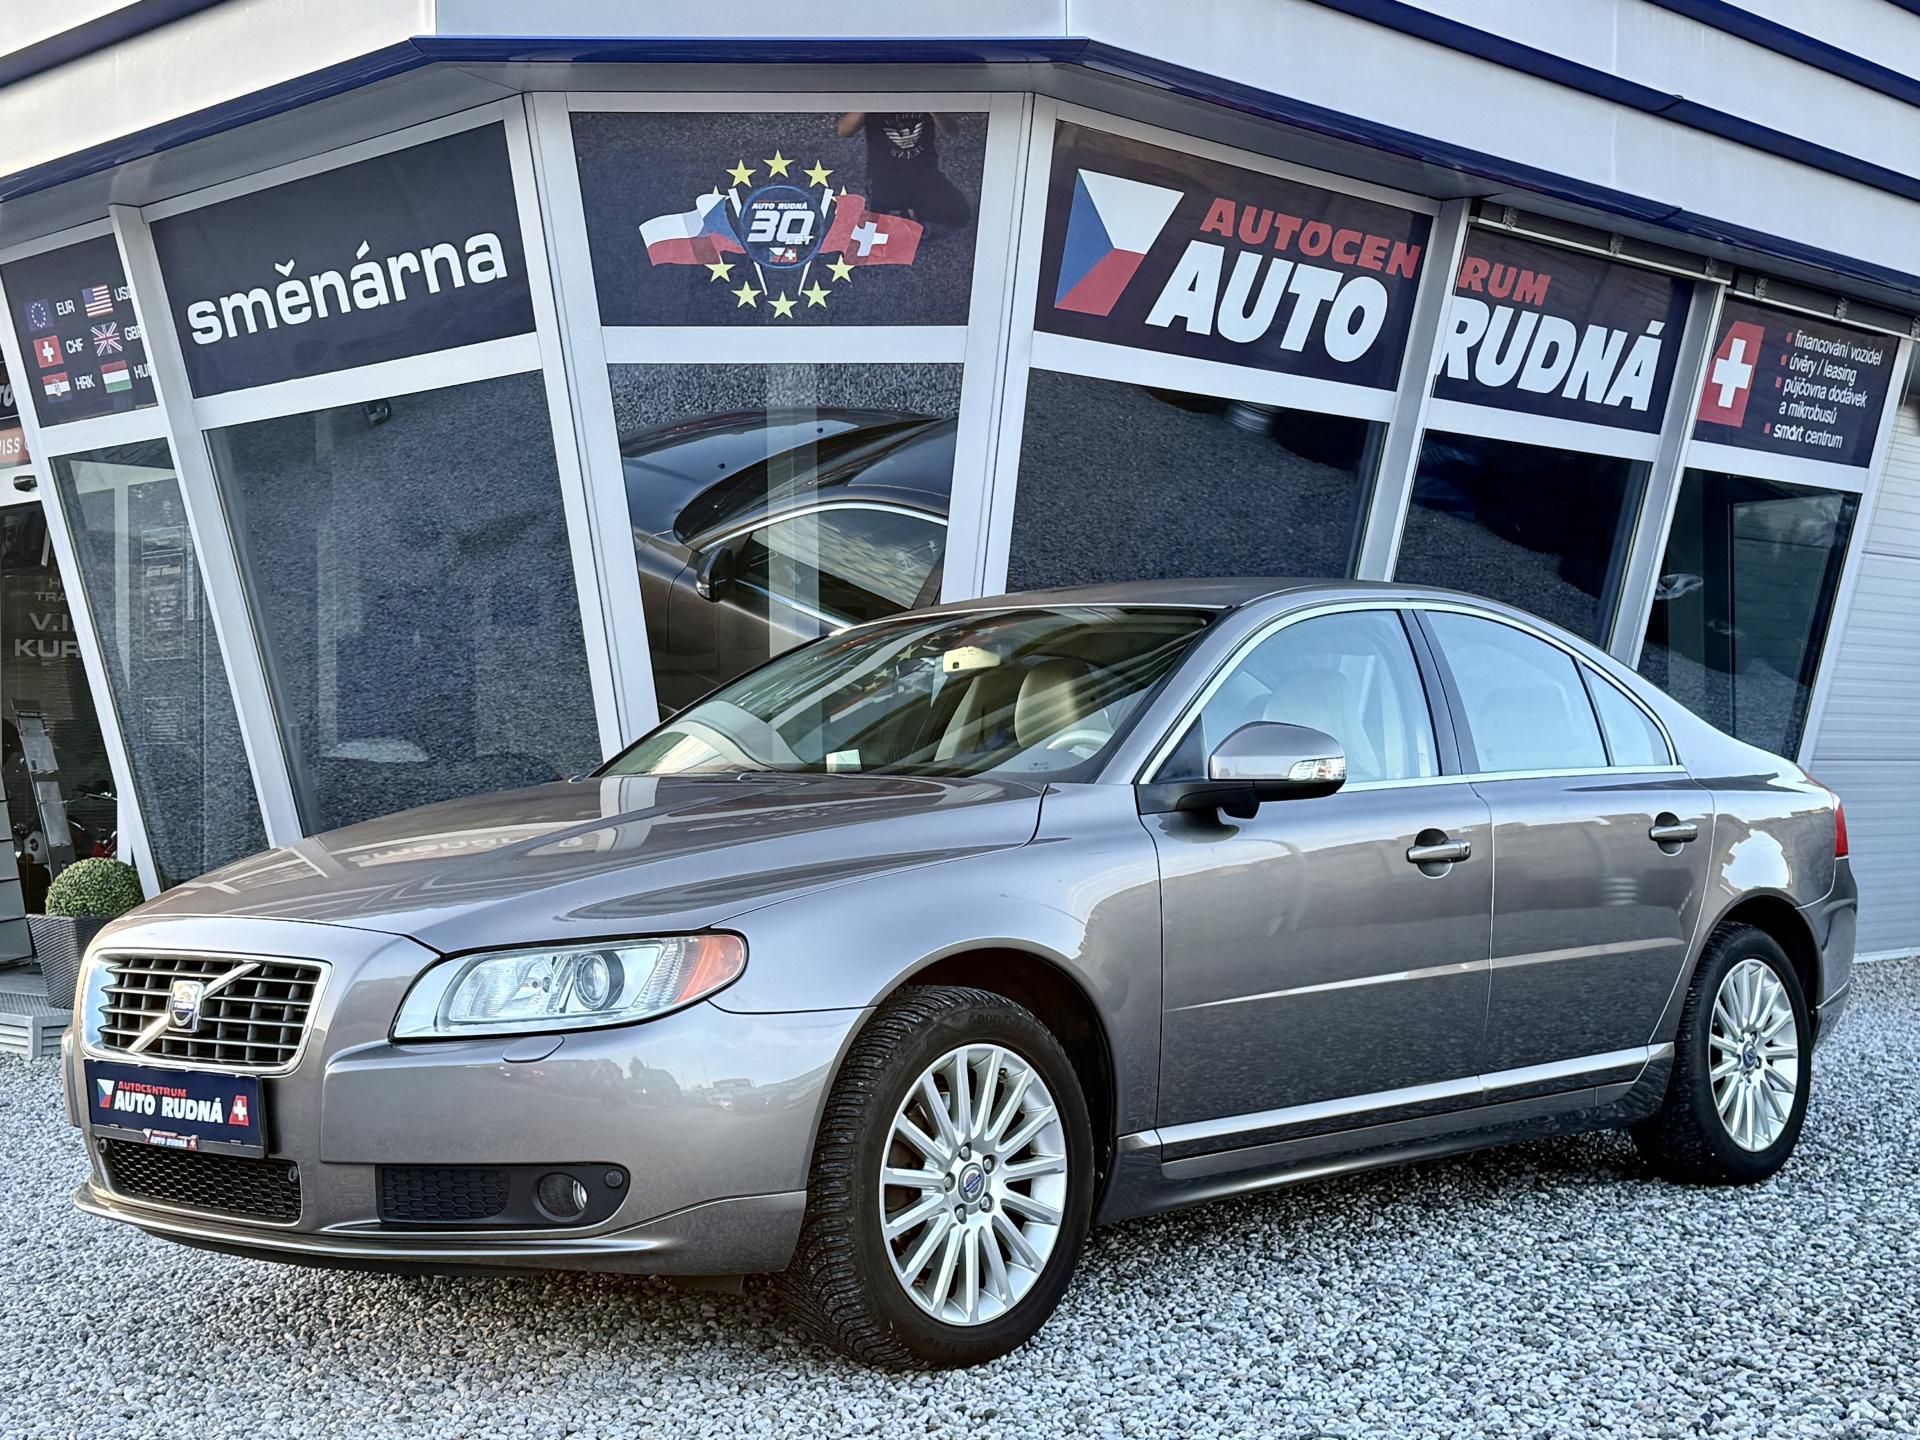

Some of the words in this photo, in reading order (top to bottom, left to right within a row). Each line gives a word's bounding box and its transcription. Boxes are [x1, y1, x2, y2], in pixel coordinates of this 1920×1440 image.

[751, 202, 776, 210] AUTO
[747, 210, 815, 242] 30
[187, 232, 508, 345] směnárna
[55, 299, 76, 316] EUR
[1145, 240, 1389, 363] AUTO
[1438, 296, 1666, 412] RUDNÁ
[65, 338, 84, 354] CHF
[1794, 329, 1851, 359] financování
[1850, 346, 1883, 366] vozidel
[1789, 352, 1818, 379] úvěry
[1823, 360, 1858, 387] leasing
[74, 374, 96, 390] HRK
[1828, 385, 1868, 408] dodávek
[1779, 401, 1787, 415] a
[1804, 430, 1843, 449] centrum
[118, 1081, 188, 1098] AUTOCENTRUM
[113, 1090, 156, 1116] AUTO
[161, 1097, 224, 1123] RUDNÁ
